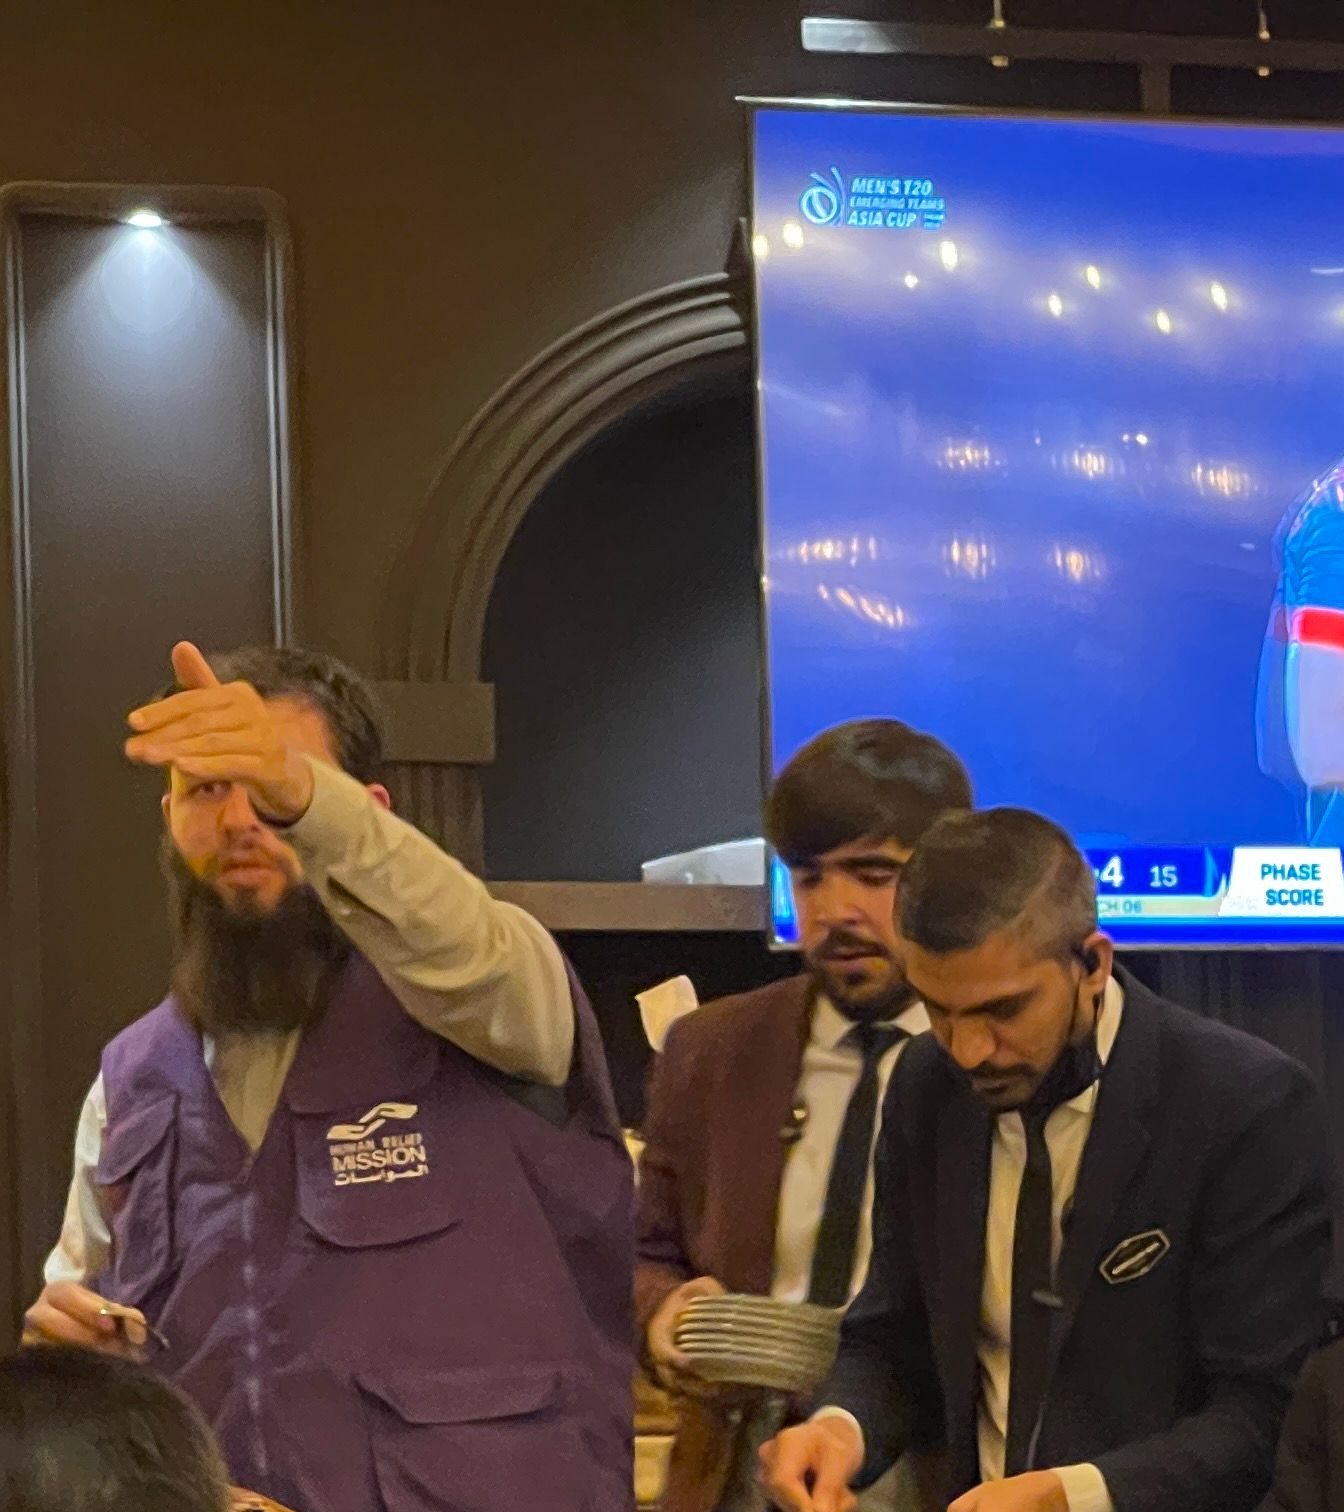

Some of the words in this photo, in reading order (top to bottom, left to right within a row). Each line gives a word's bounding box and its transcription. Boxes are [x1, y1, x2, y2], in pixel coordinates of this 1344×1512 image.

[851, 177, 900, 195] MEN'S
[903, 179, 933, 196] T20
[847, 210, 882, 225] ASIA
[886, 211, 917, 227] CUP
[1149, 864, 1179, 888] 15
[1260, 863, 1322, 881] PHASE
[1265, 888, 1324, 906] SCORE
[331, 1145, 426, 1174] MISSION
